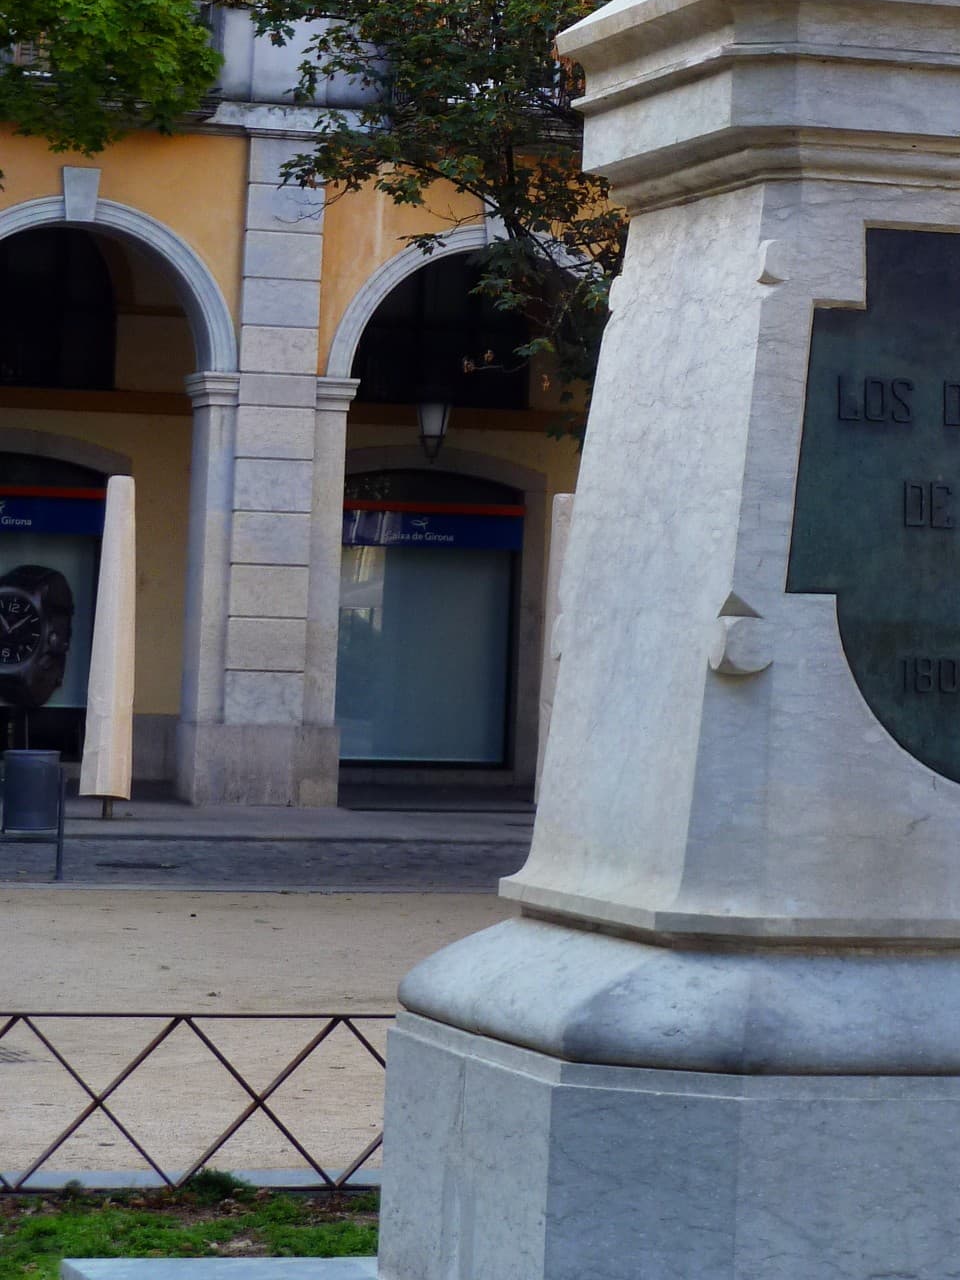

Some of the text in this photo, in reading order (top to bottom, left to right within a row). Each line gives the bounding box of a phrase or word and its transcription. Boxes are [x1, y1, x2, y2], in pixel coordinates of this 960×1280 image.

[836, 374, 915, 425] LOS
[901, 478, 955, 529] DE
[1, 515, 32, 526] Girona
[411, 531, 423, 541] de
[424, 532, 454, 542] Girona
